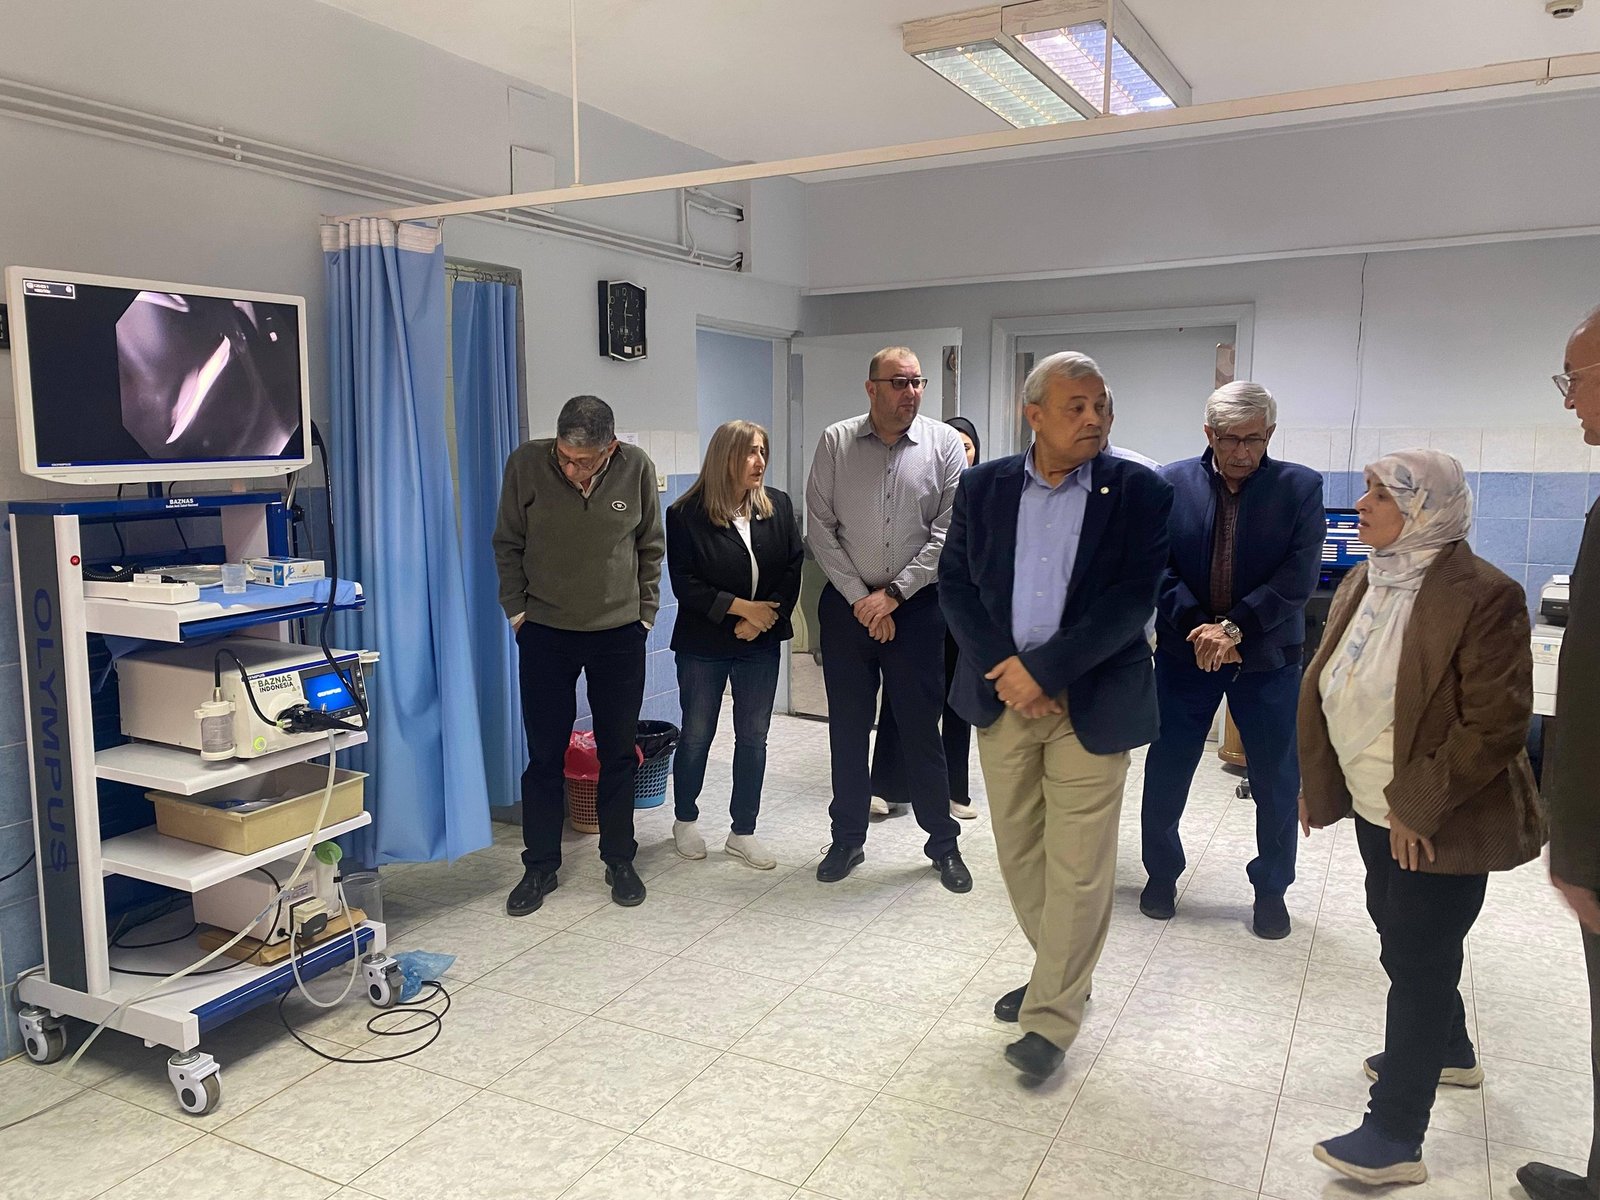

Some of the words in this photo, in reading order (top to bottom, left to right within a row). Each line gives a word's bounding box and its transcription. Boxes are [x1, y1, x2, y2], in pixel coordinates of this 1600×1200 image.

[257, 674, 293, 687] BAZNAS
[259, 681, 294, 693] INDONESIA
[33, 587, 69, 873] OLYMPUS
